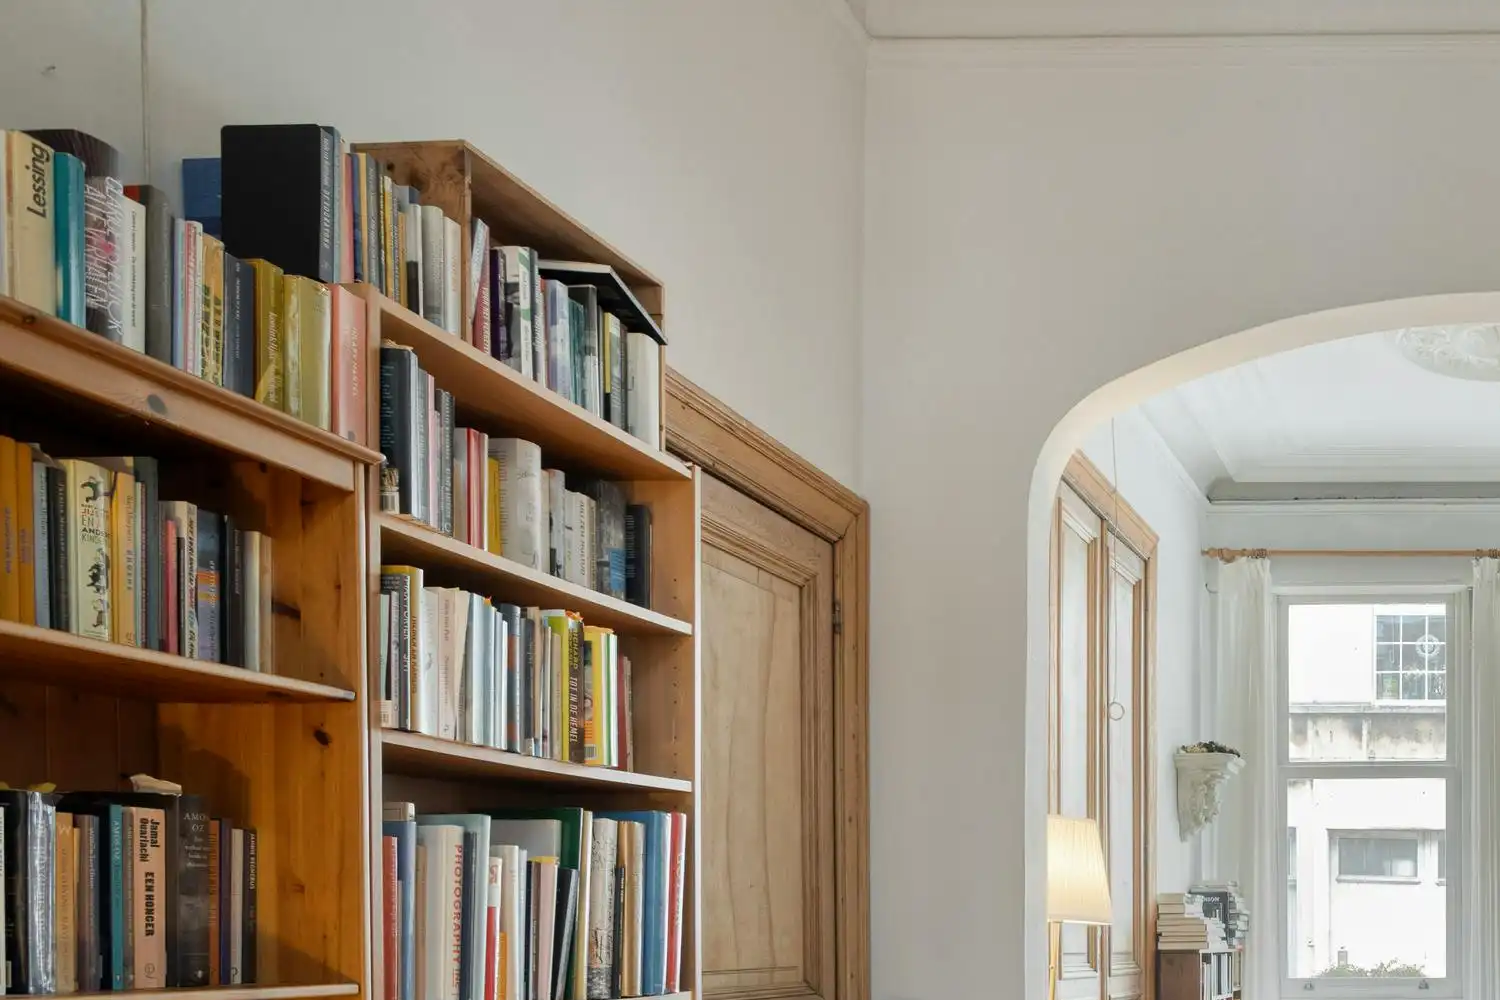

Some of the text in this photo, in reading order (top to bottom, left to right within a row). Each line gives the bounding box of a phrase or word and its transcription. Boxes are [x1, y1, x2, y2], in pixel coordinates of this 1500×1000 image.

[26, 143, 50, 219] Lessing
[569, 716, 579, 743] HEMEL
[139, 817, 151, 863] Ouariachi
[149, 818, 161, 848] Jamal
[144, 871, 155, 937] EEN HONGER
[450, 844, 464, 964] PHOTOGRAPHY
